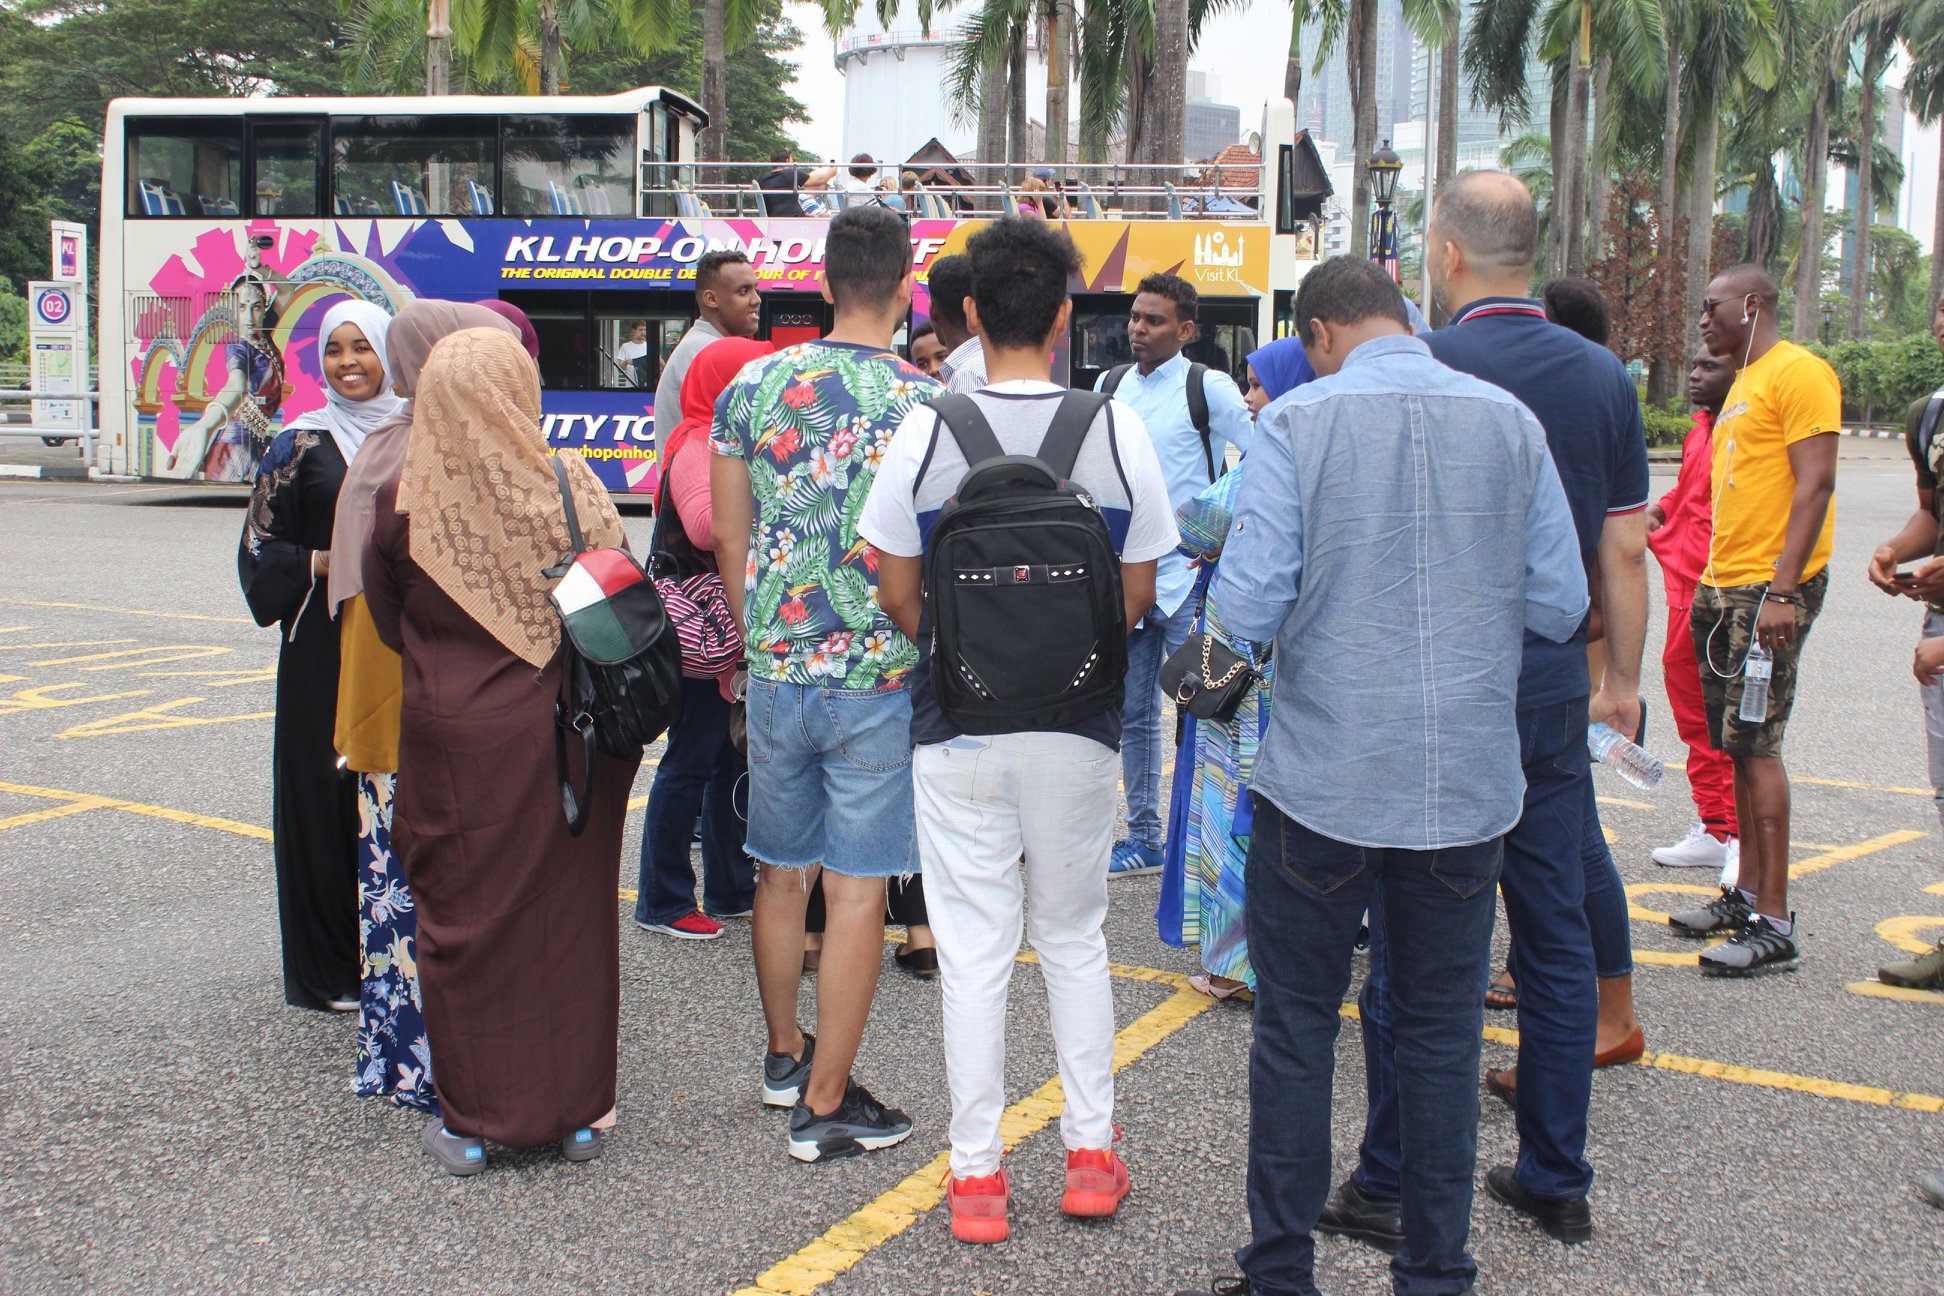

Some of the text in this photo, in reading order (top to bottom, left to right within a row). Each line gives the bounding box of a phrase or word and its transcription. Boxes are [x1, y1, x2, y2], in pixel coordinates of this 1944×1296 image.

[62, 241, 75, 254] KL
[505, 236, 561, 263] KL
[500, 267, 533, 279] THE
[533, 267, 606, 279] ORIGINAL
[609, 268, 674, 280] DOUBLE
[676, 268, 697, 280] DE
[753, 269, 784, 280] OUR
[787, 269, 812, 281] OF
[1194, 267, 1244, 282] Visit KL
[46, 300, 63, 313] 02
[539, 414, 656, 442] ITY TO
